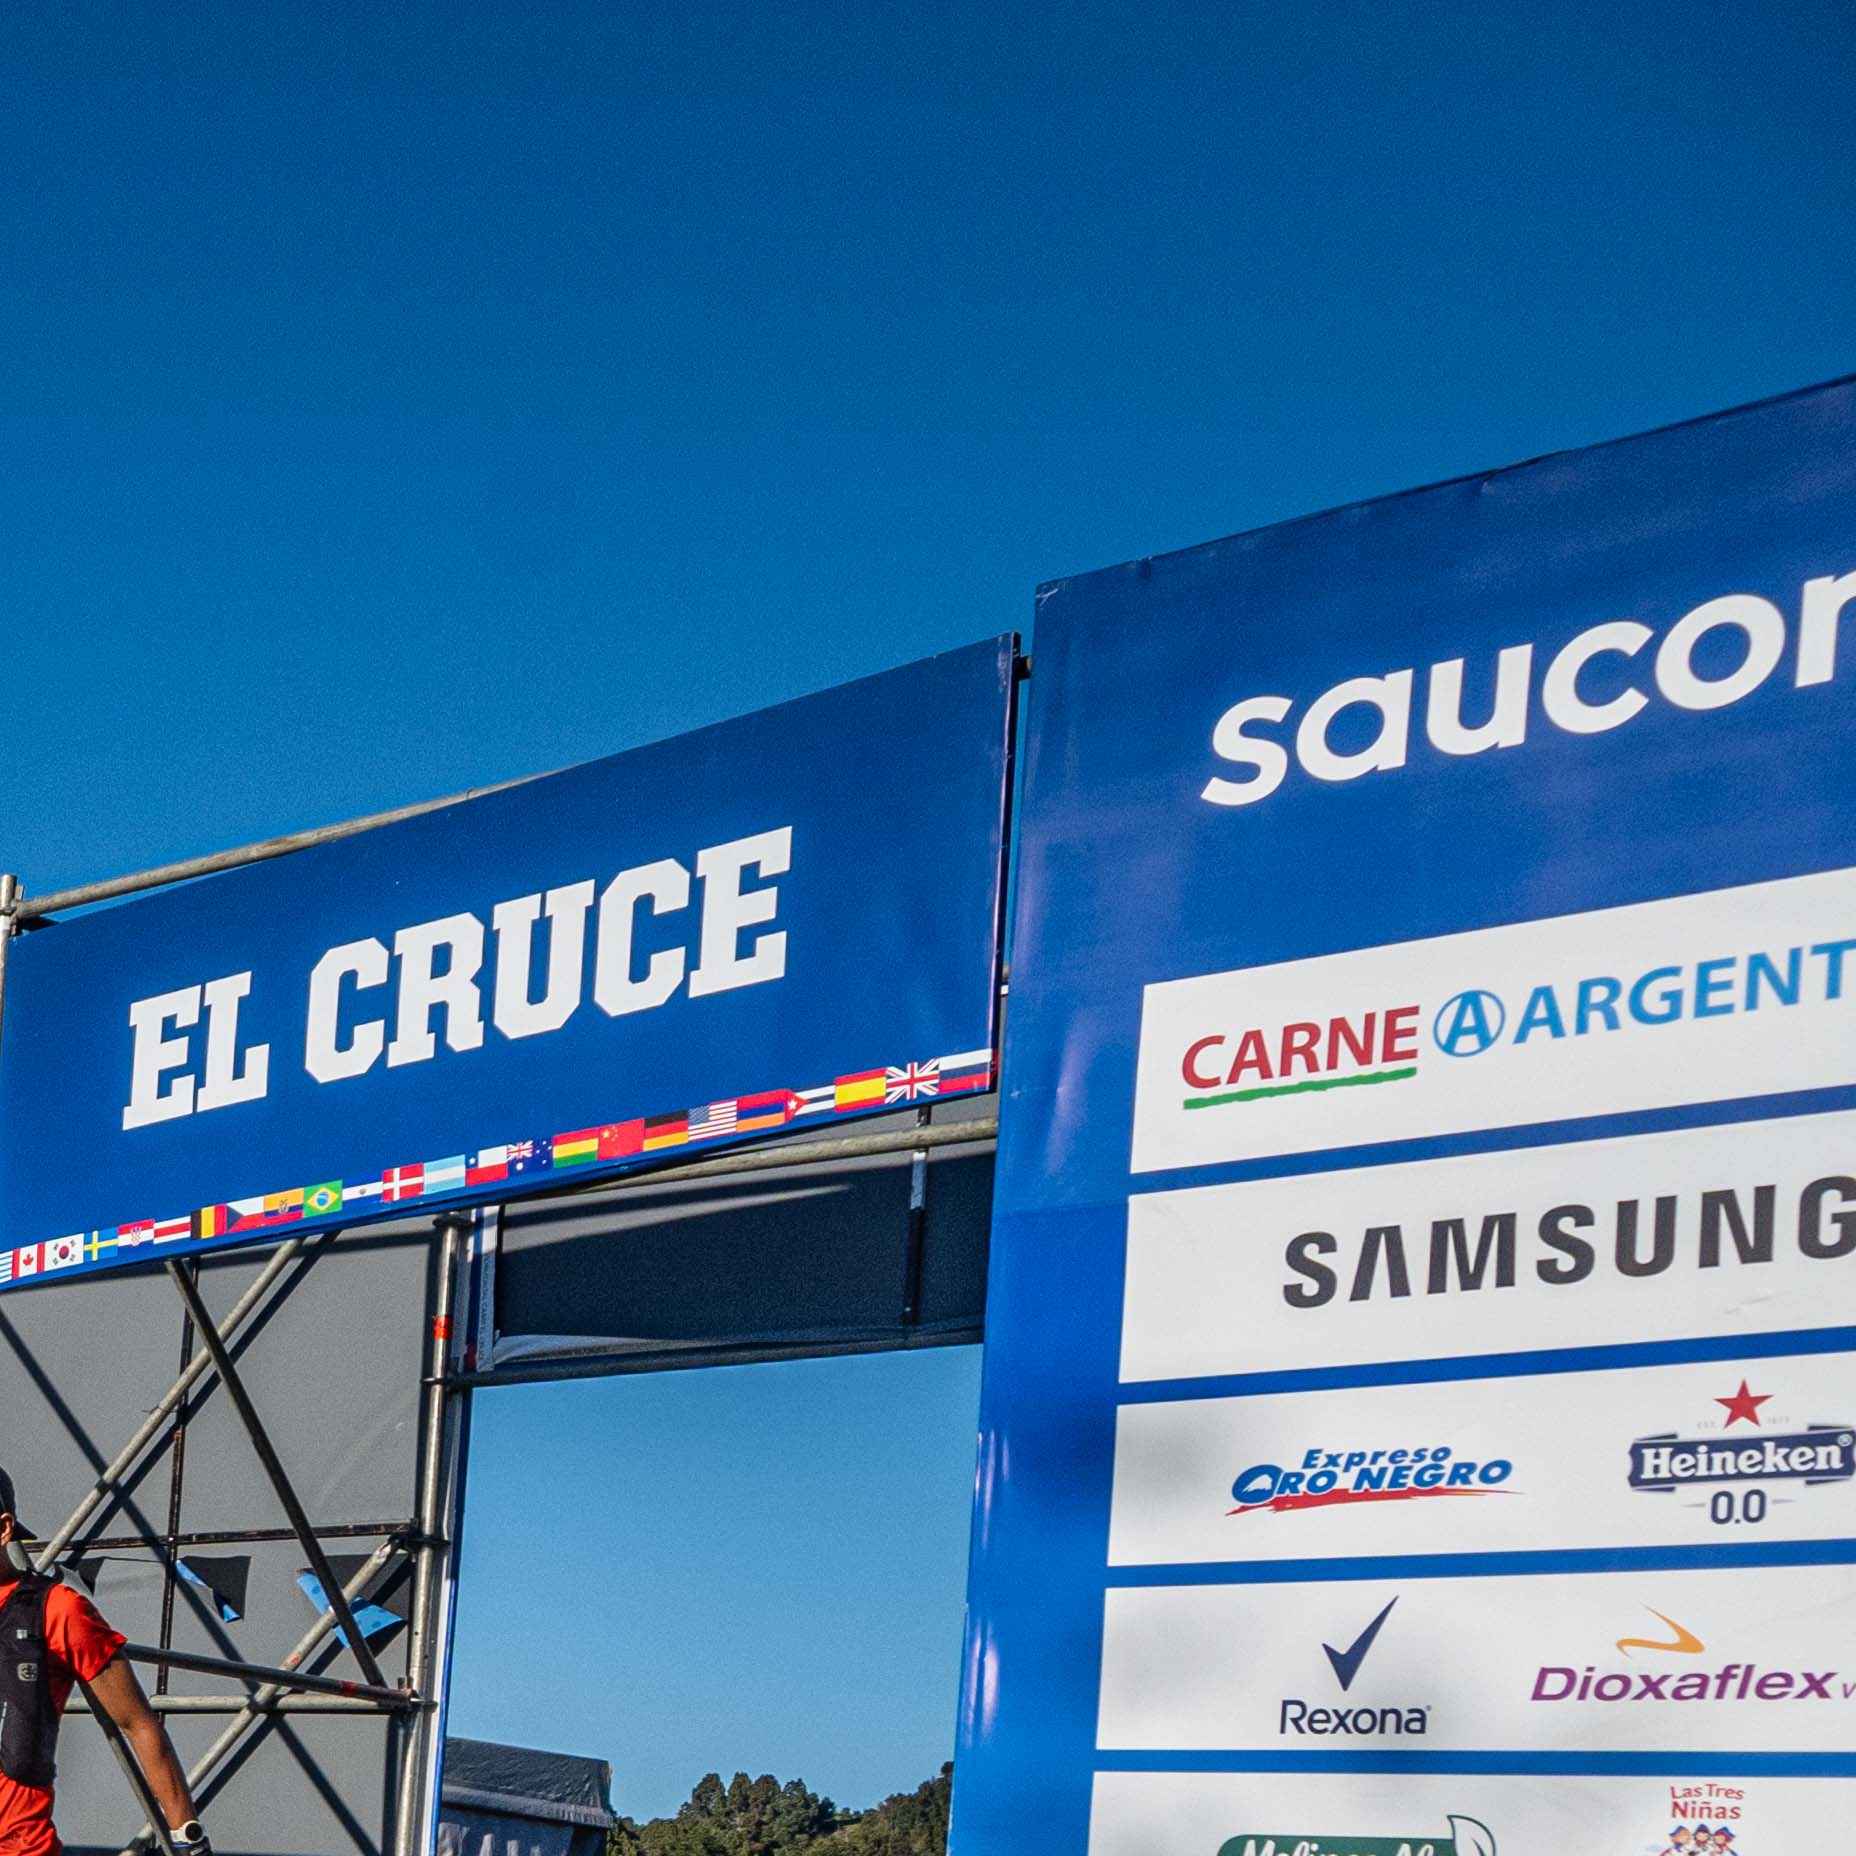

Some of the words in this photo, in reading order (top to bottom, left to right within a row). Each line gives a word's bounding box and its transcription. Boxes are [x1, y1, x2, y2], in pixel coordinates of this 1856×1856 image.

[122, 970, 270, 1131] EL
[303, 825, 793, 1085] CRUCE
[1182, 1006, 1419, 1089] CARNE
[1513, 940, 1856, 1045] ARGENT
[1283, 1175, 1856, 1309] SAMSUNG
[1302, 1447, 1452, 1472] Expreso
[1641, 1441, 1844, 1480] Heineken
[1231, 1464, 1338, 1504] ORO
[1352, 1460, 1512, 1491] NEGRO
[1710, 1489, 1767, 1525] 0.0
[1531, 1664, 1839, 1701] Dioxaflex
[1280, 1699, 1428, 1735] Rexona
[1670, 1785, 1703, 1799] Las
[1705, 1783, 1745, 1800] Tres
[1671, 1801, 1742, 1819] Niñas
